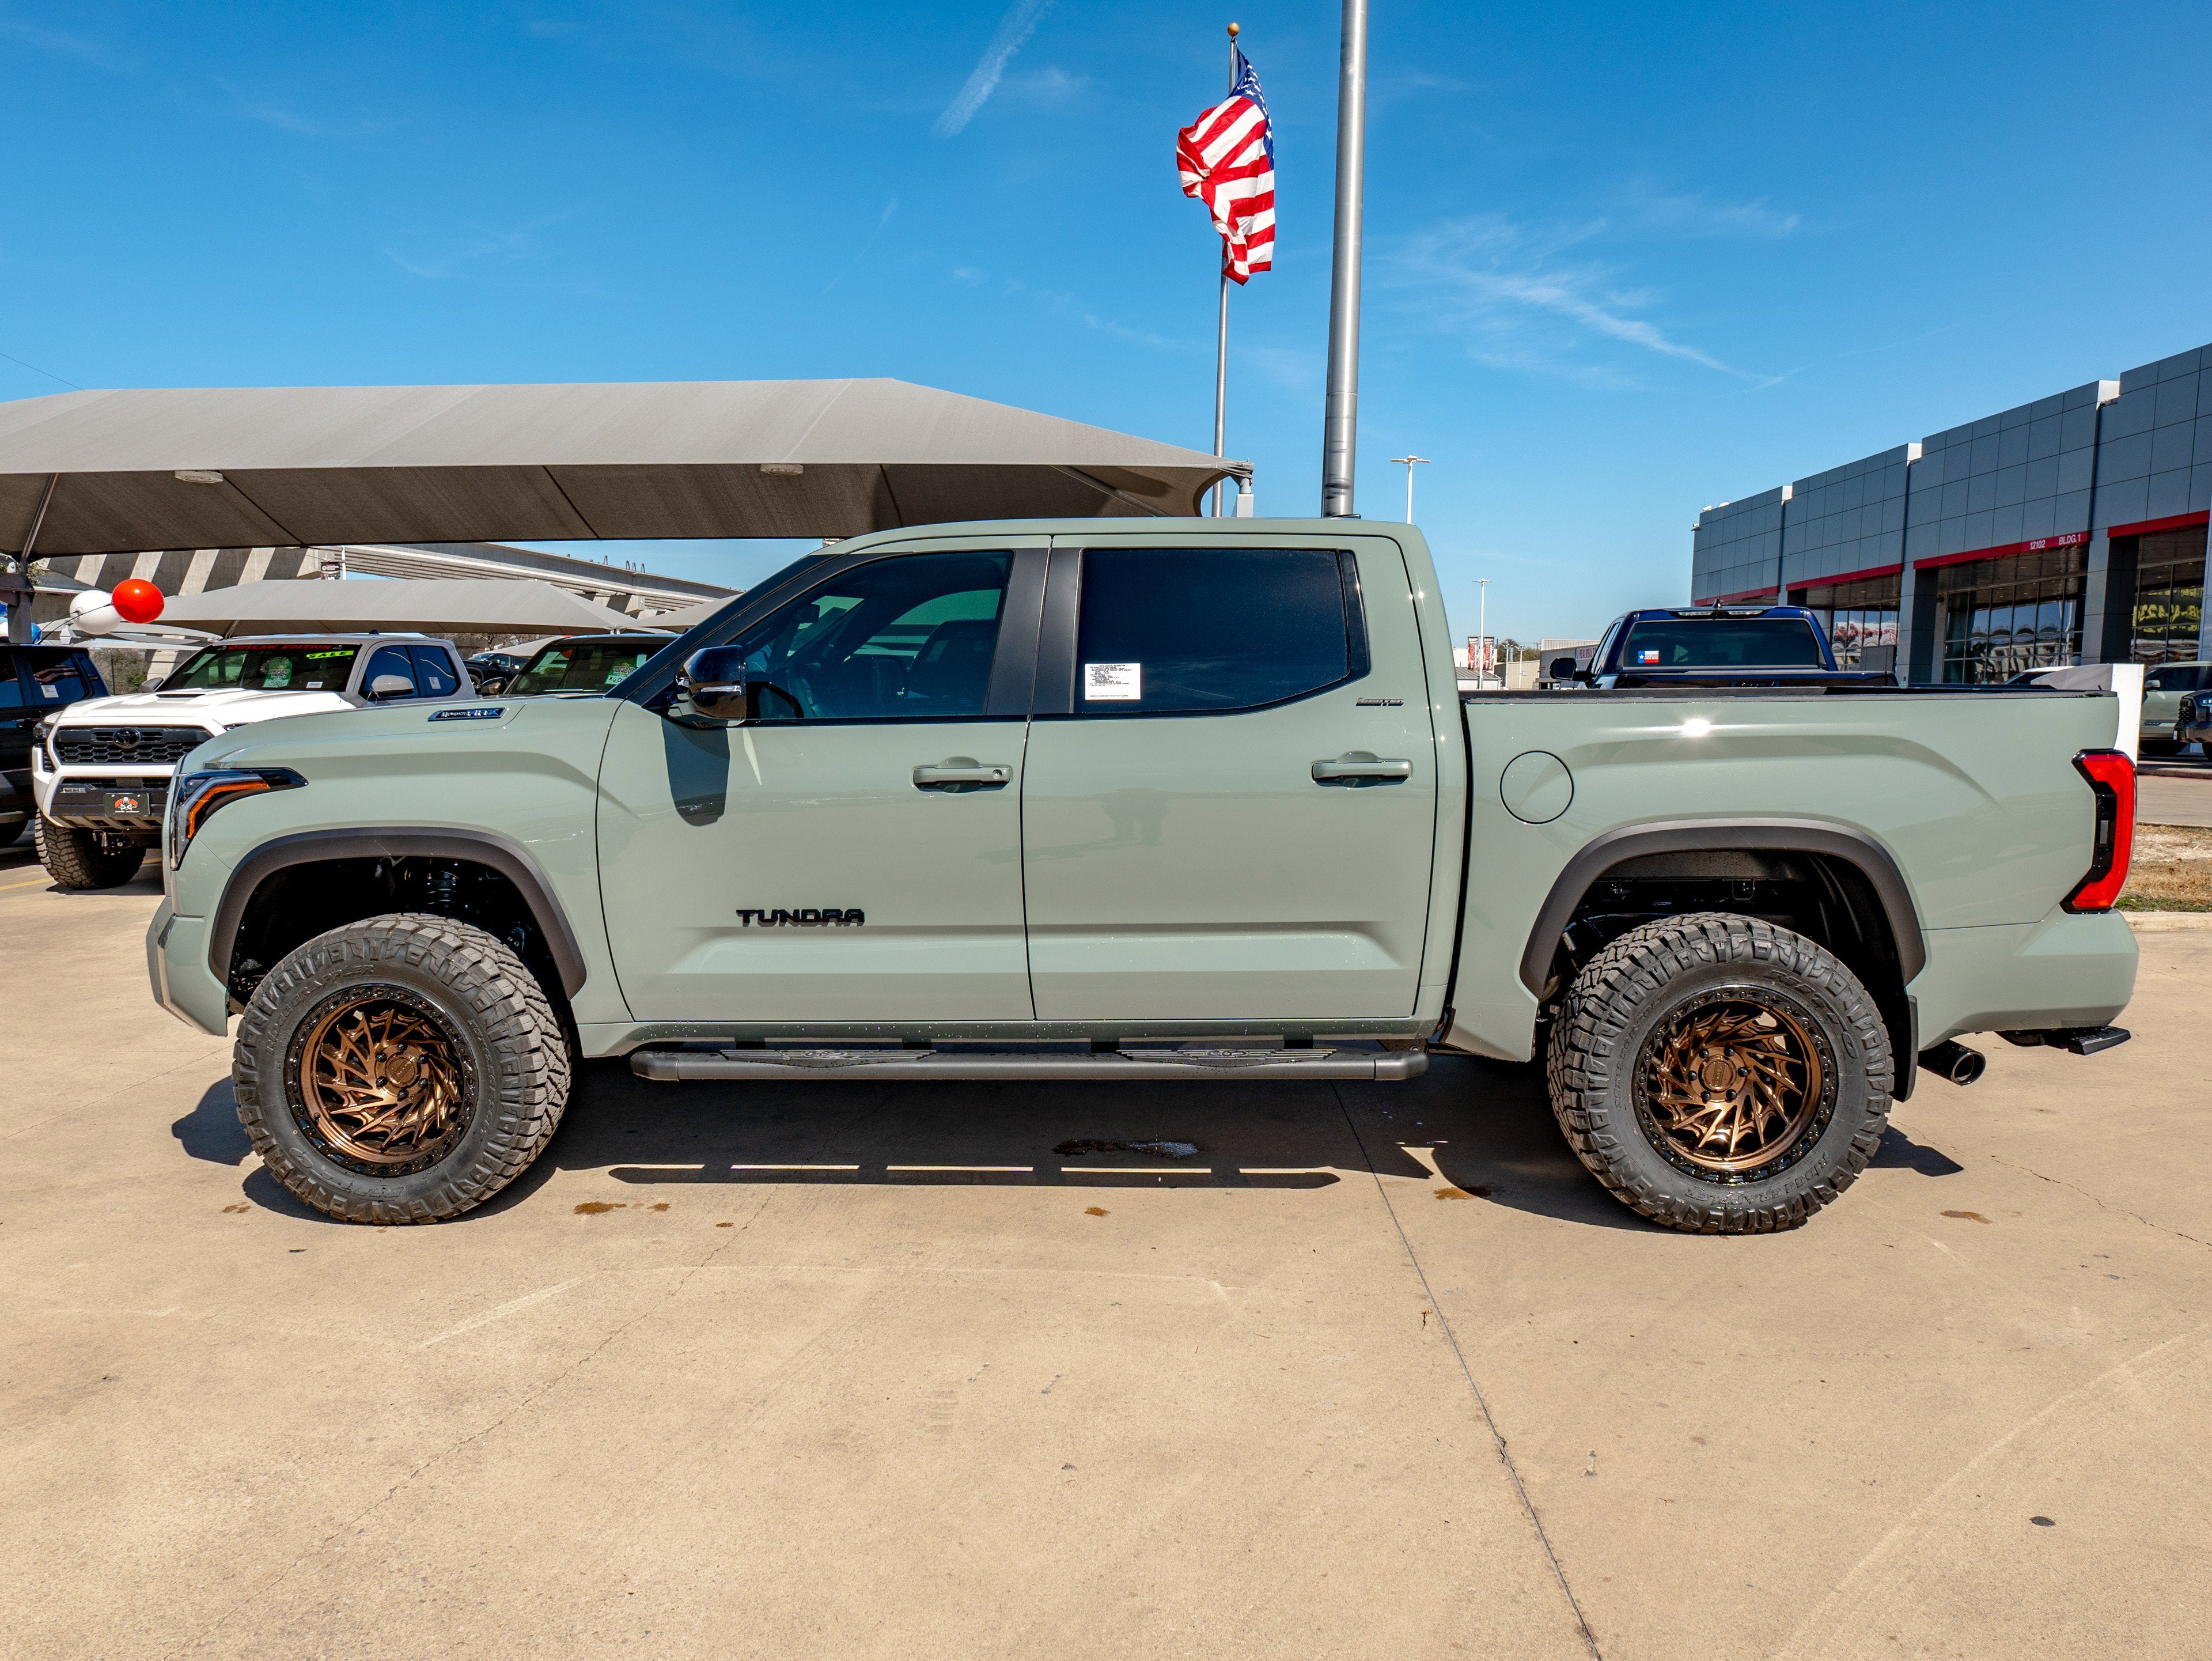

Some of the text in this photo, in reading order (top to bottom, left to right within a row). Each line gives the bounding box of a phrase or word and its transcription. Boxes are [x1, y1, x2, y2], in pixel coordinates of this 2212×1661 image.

[2029, 539, 2046, 549] 12102
[308, 650, 349, 659] SALE
[736, 909, 865, 927] TUNDRA
[1763, 969, 1859, 1059] NITTO
